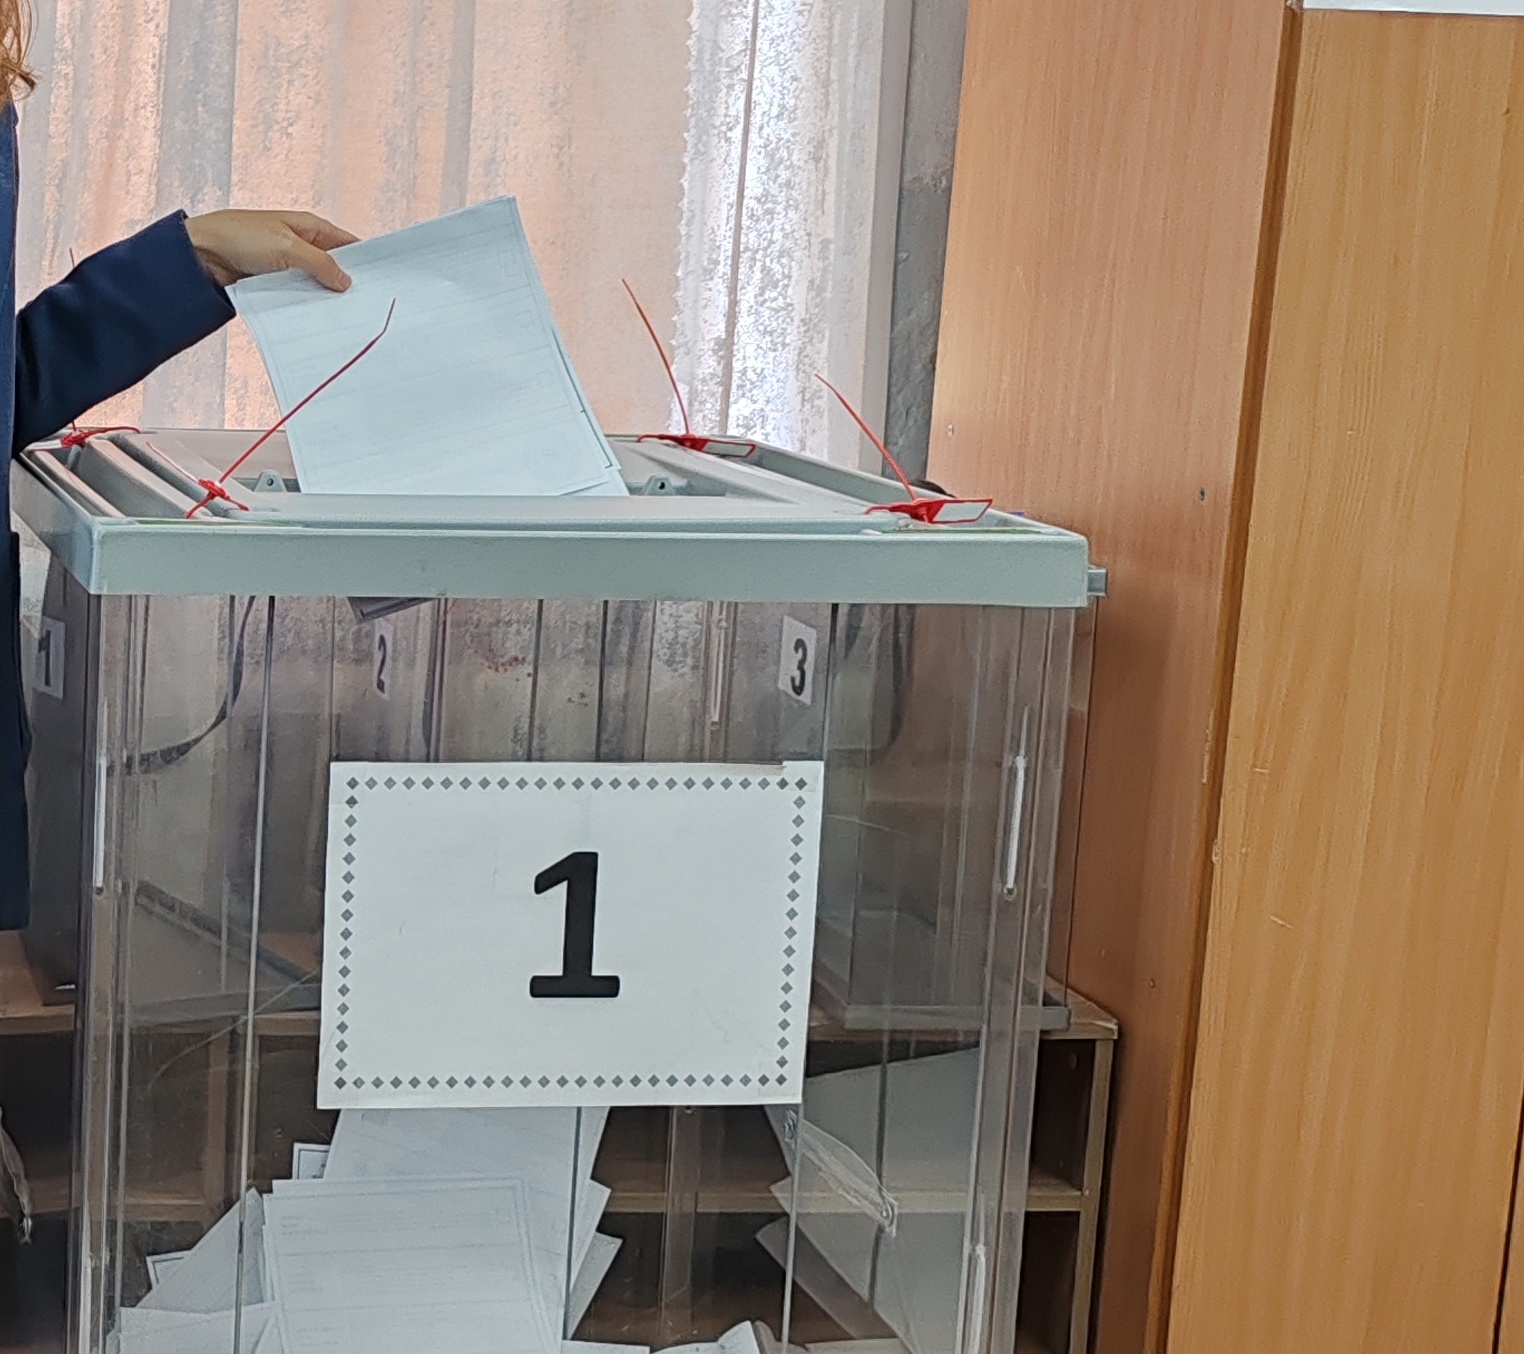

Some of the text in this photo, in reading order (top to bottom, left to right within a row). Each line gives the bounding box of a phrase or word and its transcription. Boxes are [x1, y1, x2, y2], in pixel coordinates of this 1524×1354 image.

[377, 634, 387, 694] 2
[790, 638, 808, 697] 3
[529, 851, 620, 998] 1
